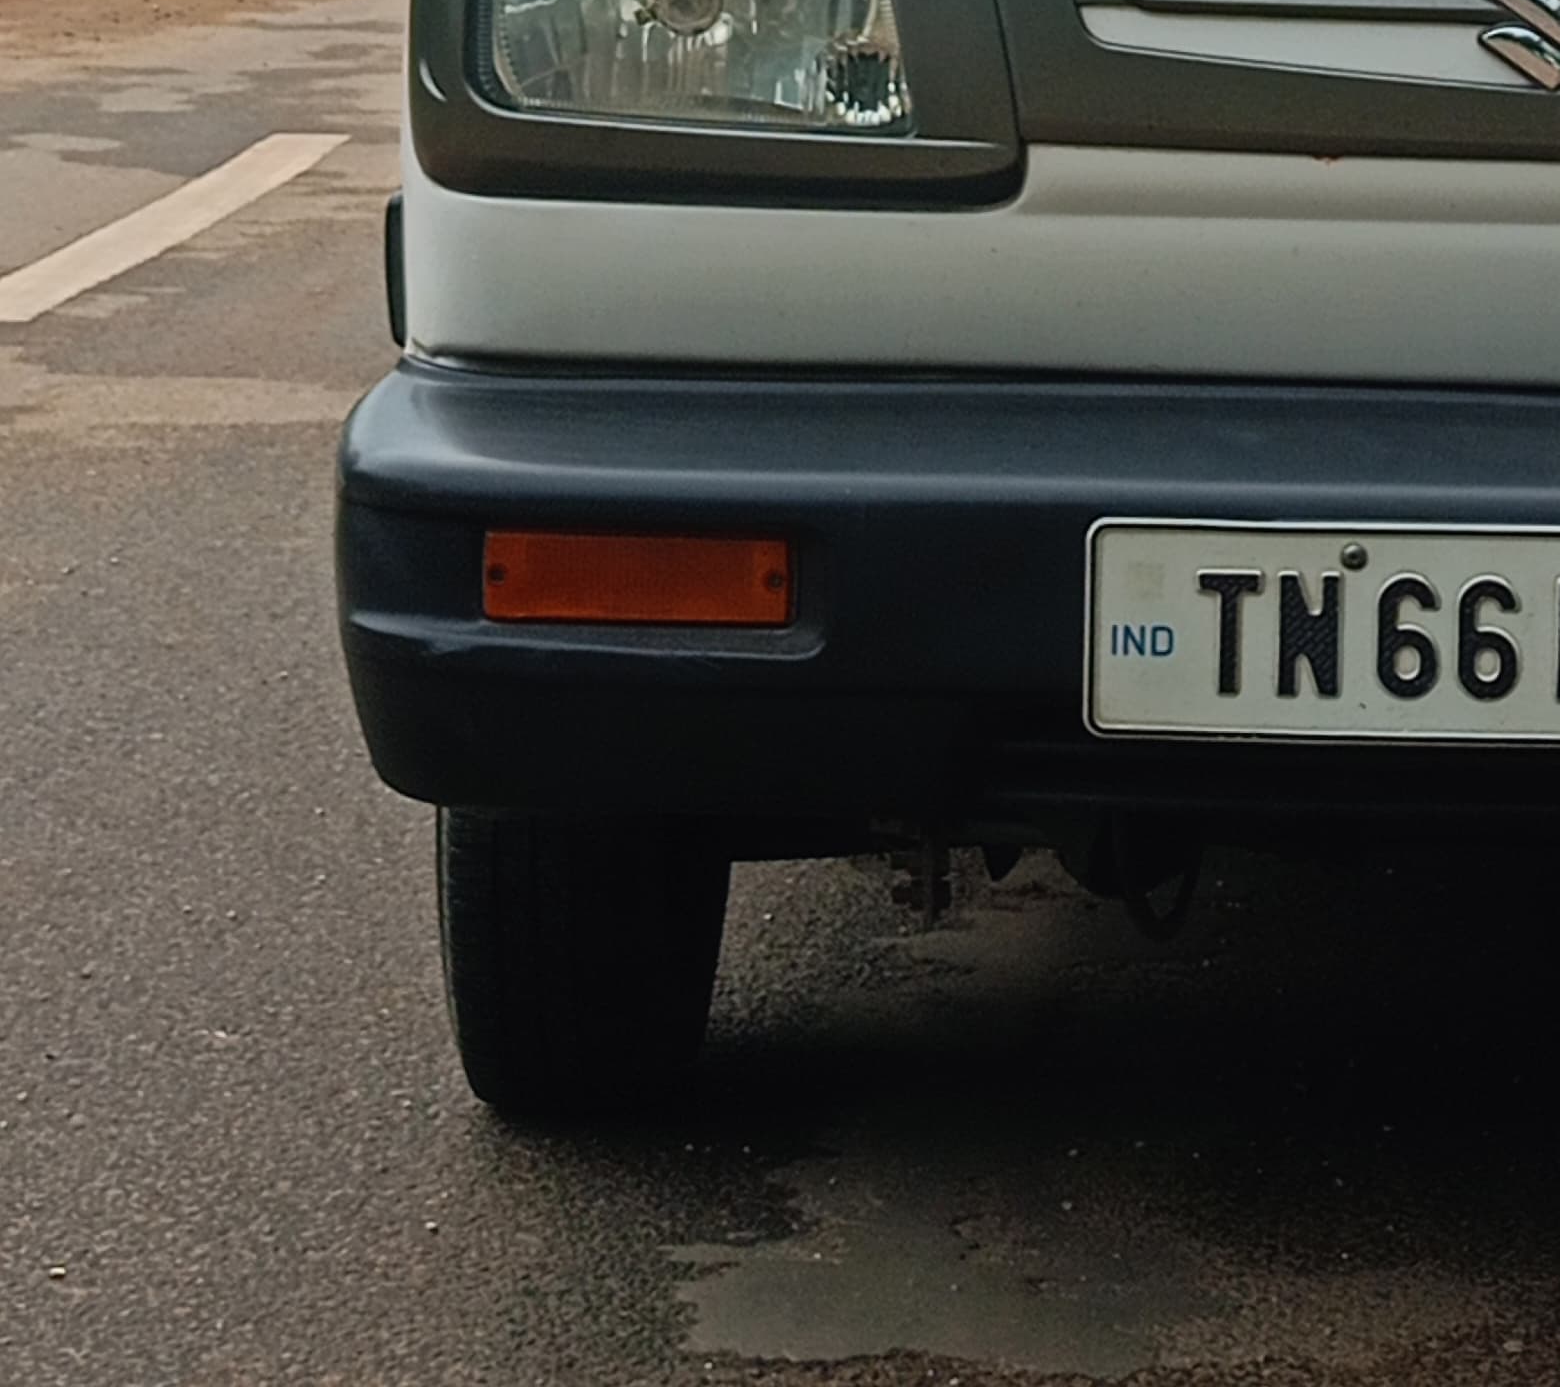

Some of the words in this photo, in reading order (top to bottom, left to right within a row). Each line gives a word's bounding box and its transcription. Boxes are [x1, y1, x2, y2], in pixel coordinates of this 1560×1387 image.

[1111, 624, 1174, 656] IND
[1199, 572, 1343, 698] TN
[1376, 577, 1520, 702] 66
